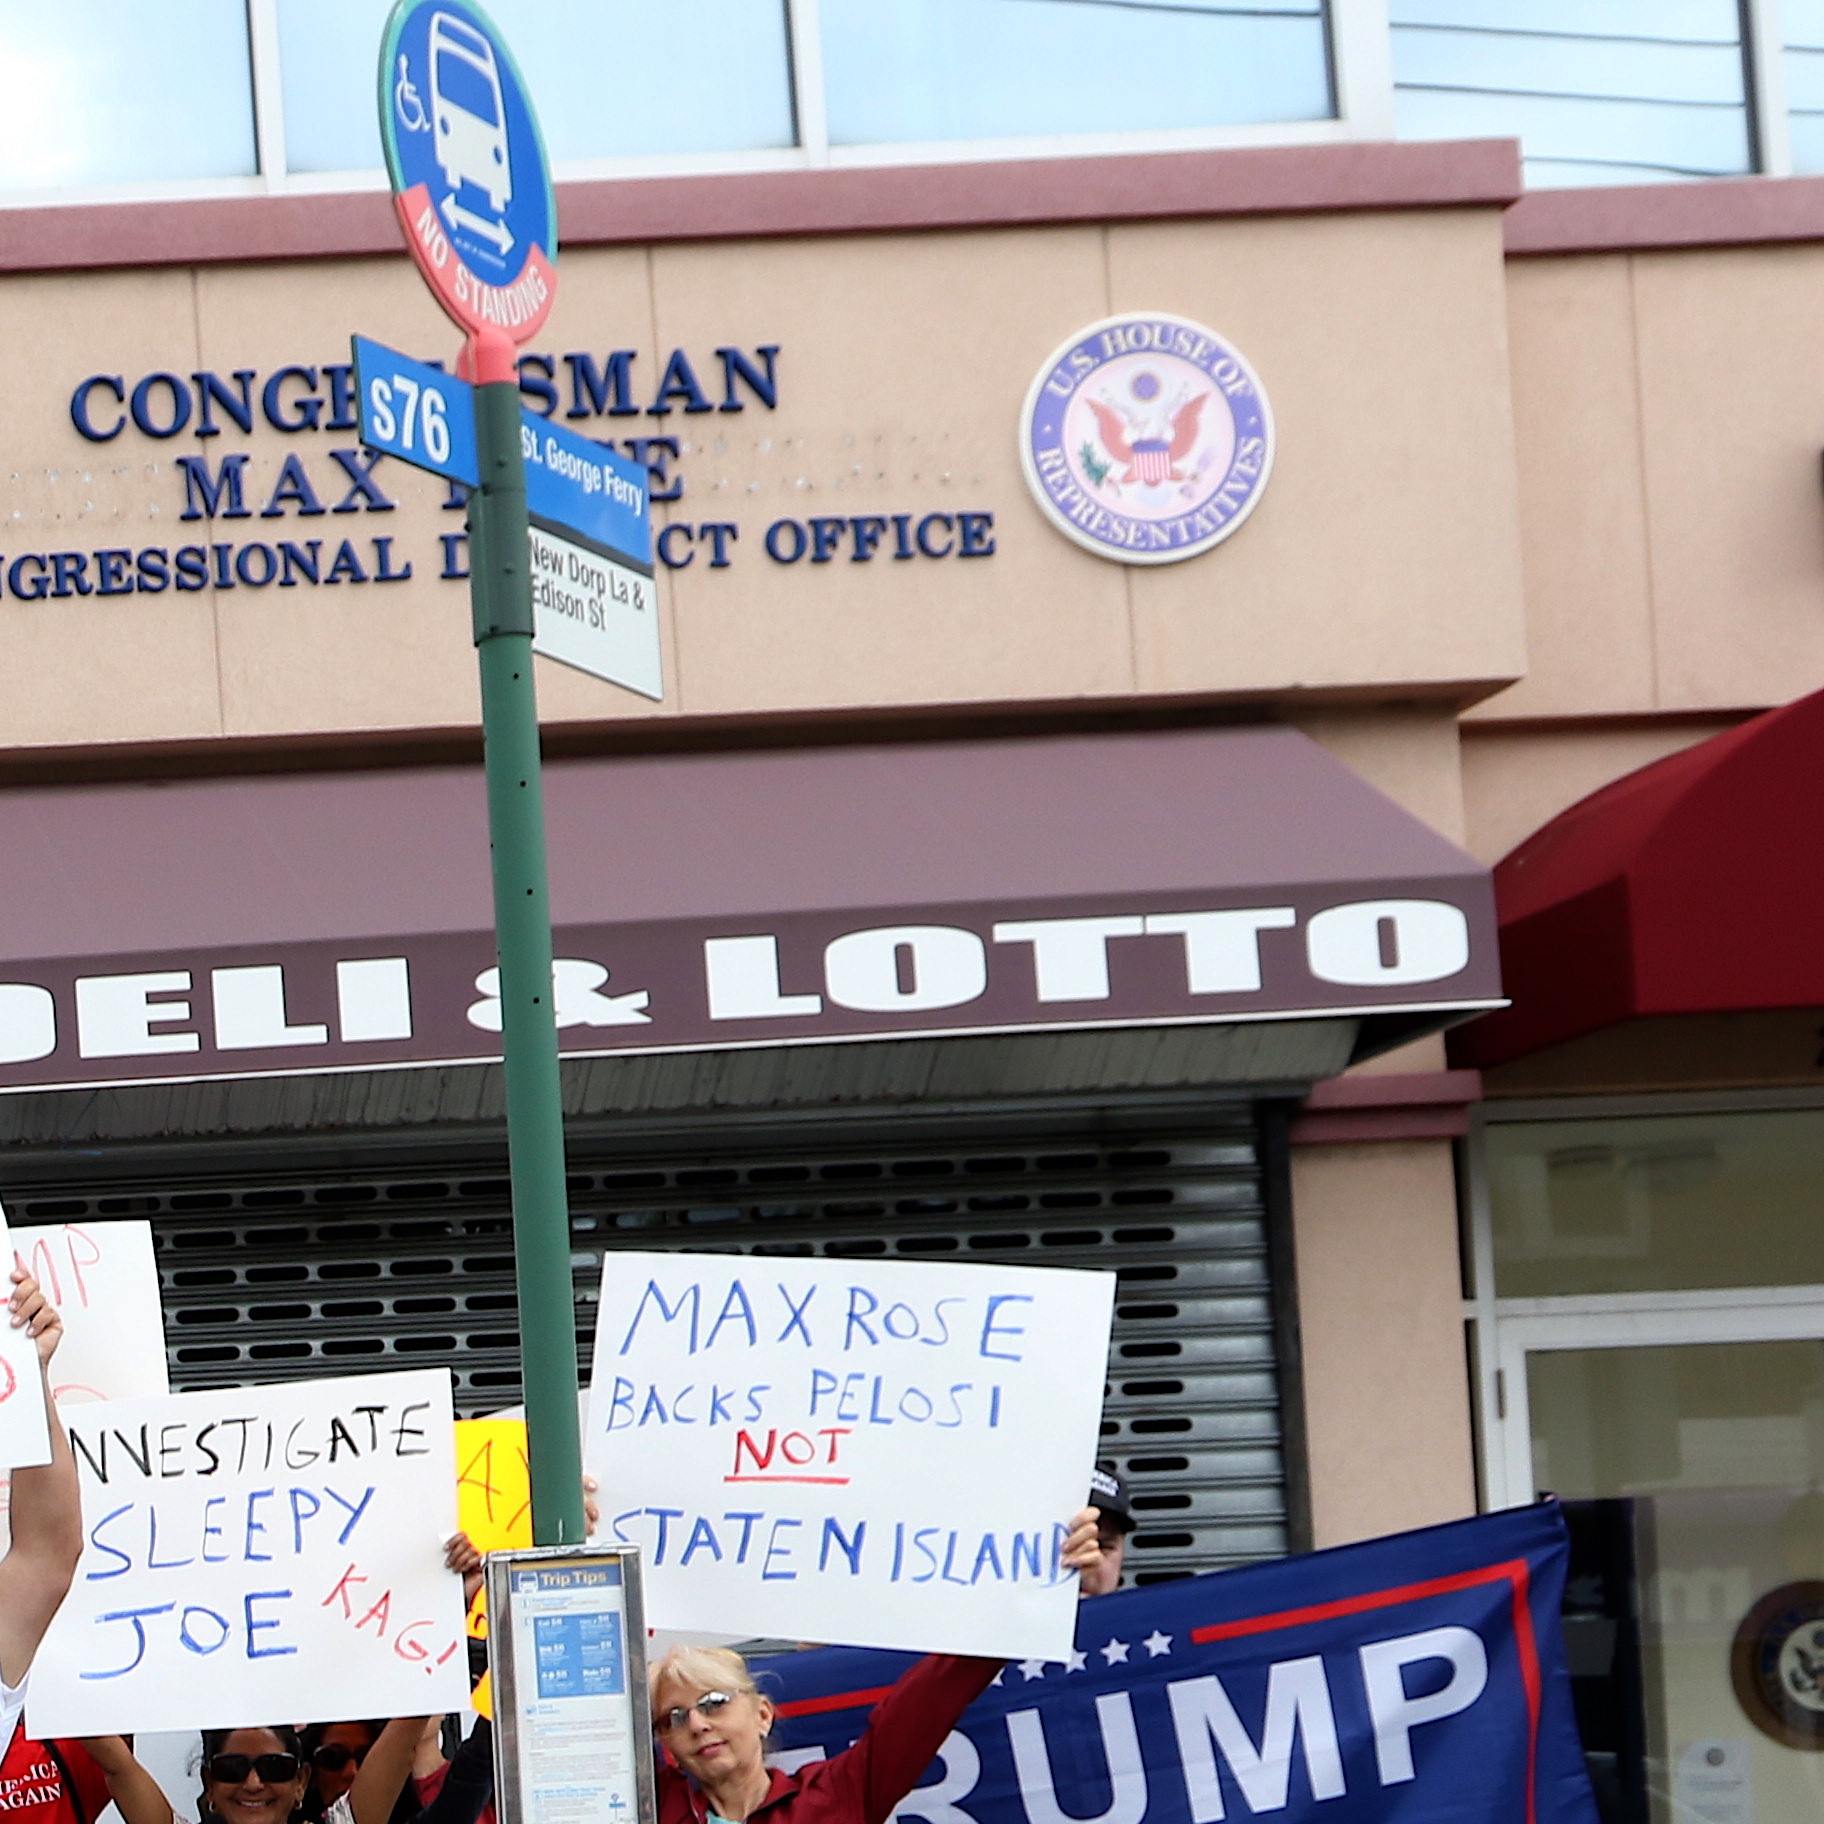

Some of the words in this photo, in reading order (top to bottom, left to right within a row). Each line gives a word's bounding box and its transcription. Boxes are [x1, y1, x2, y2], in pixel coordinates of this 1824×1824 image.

[416, 207, 450, 269] NO
[453, 264, 549, 328] STANDING
[70, 345, 781, 441] CONGSMAN
[1048, 347, 1101, 397] U.S.
[1102, 322, 1209, 366] HOUSE
[1214, 356, 1253, 397] OF
[369, 373, 451, 464] S76
[176, 448, 396, 520] MAX
[520, 423, 541, 465] St.
[544, 442, 602, 492] George
[604, 462, 645, 518] Ferry
[1038, 435, 1264, 548] REPRESENTATIVES
[528, 531, 564, 572] New
[569, 551, 606, 598] Dorp
[609, 566, 628, 602] La
[632, 584, 645, 611] &
[764, 511, 997, 565] OFFICE
[531, 575, 584, 622] Edison
[588, 598, 606, 631] St
[467, 957, 652, 1033] &
[704, 898, 1470, 1022] LOTTO
[606, 1375, 772, 1433] BACKS
[808, 1367, 1002, 1428] PELOSI
[732, 1427, 852, 1477] NOT
[86, 1484, 377, 1581] SLEEPY
[611, 1507, 867, 1581] STATEN
[889, 1520, 1080, 1588] ISLAND
[321, 1563, 458, 1674] KAG!
[540, 1571, 571, 1587] Trip
[573, 1569, 607, 1586] Tips
[78, 1590, 298, 1680] JOE
